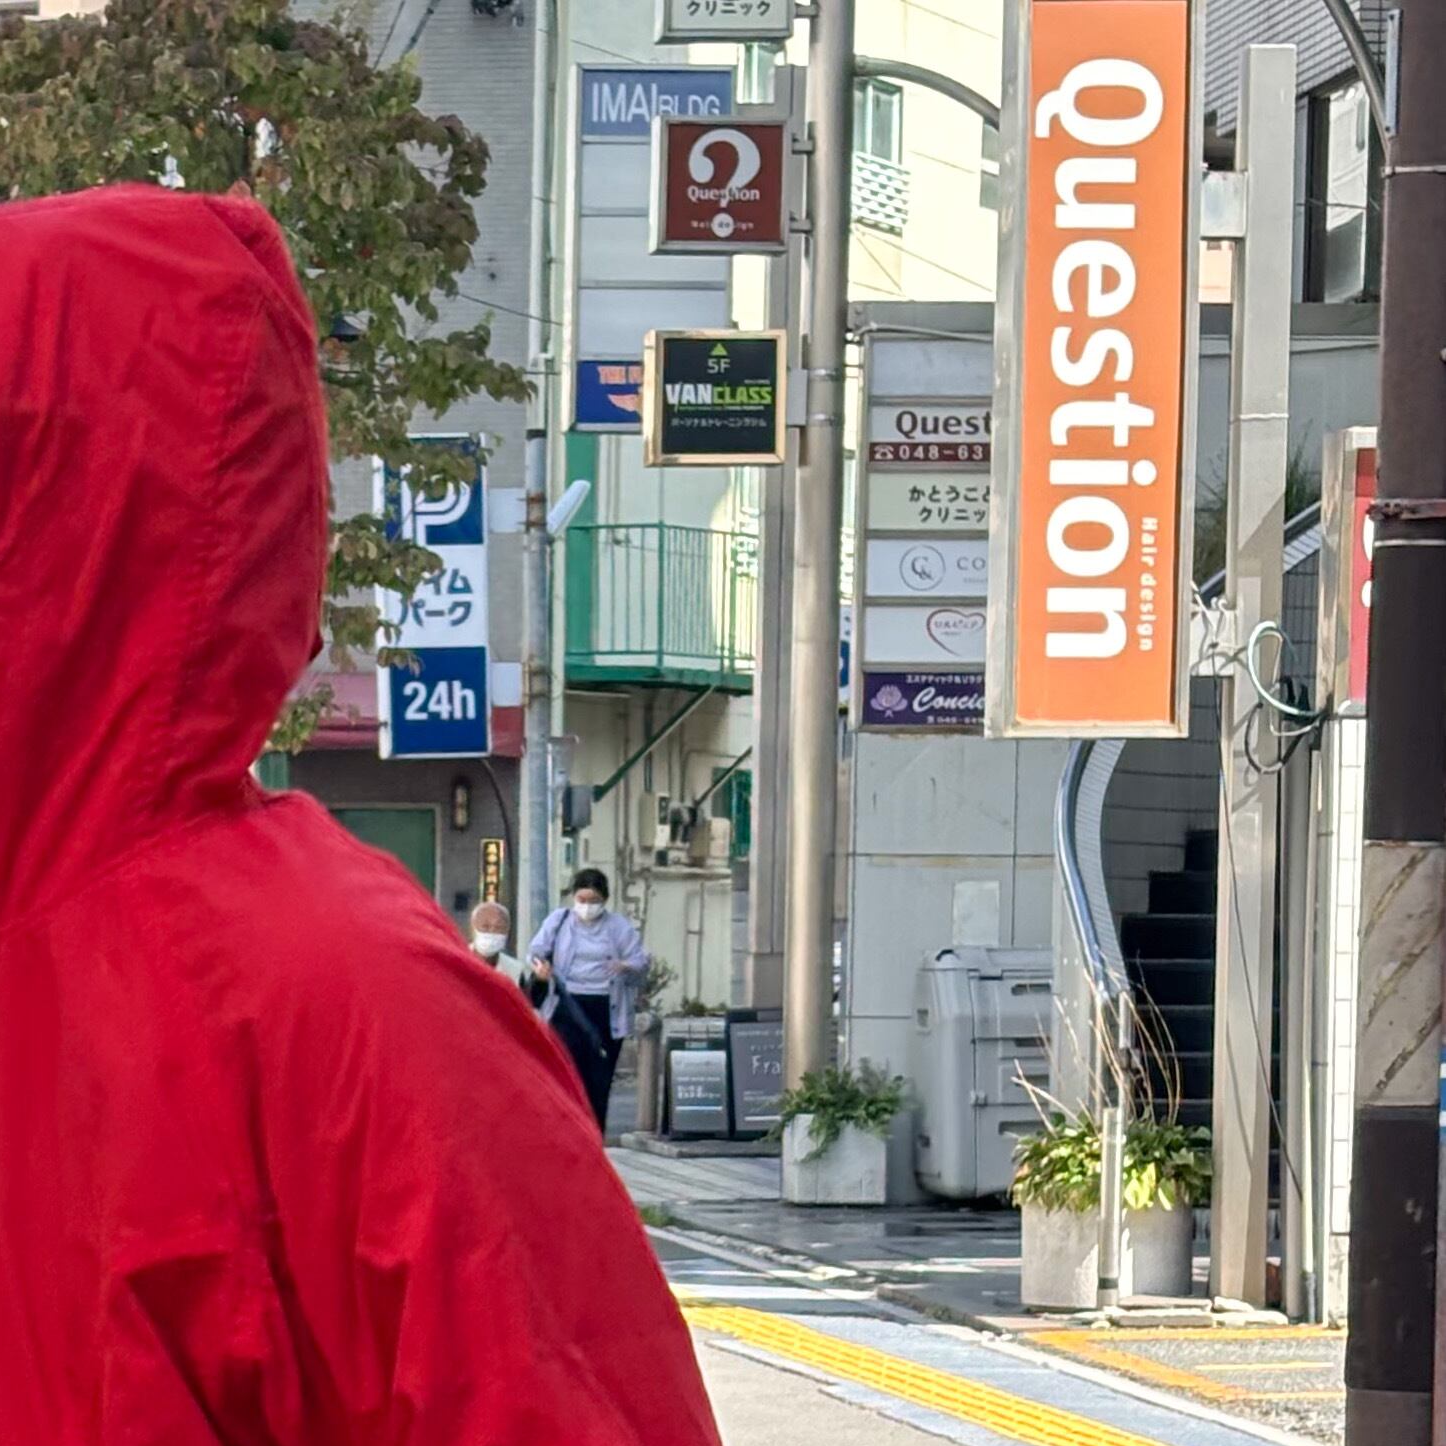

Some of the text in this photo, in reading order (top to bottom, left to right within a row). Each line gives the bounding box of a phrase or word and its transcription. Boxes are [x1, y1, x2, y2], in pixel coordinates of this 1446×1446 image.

[687, 0, 771, 16] クリニック
[707, 358, 731, 374] 5F
[1034, 58, 1164, 658] Question
[898, 444, 984, 460] 048-63
[919, 506, 986, 523] クリニッ
[1136, 517, 1158, 651] Hair design
[403, 680, 476, 721] 24h
